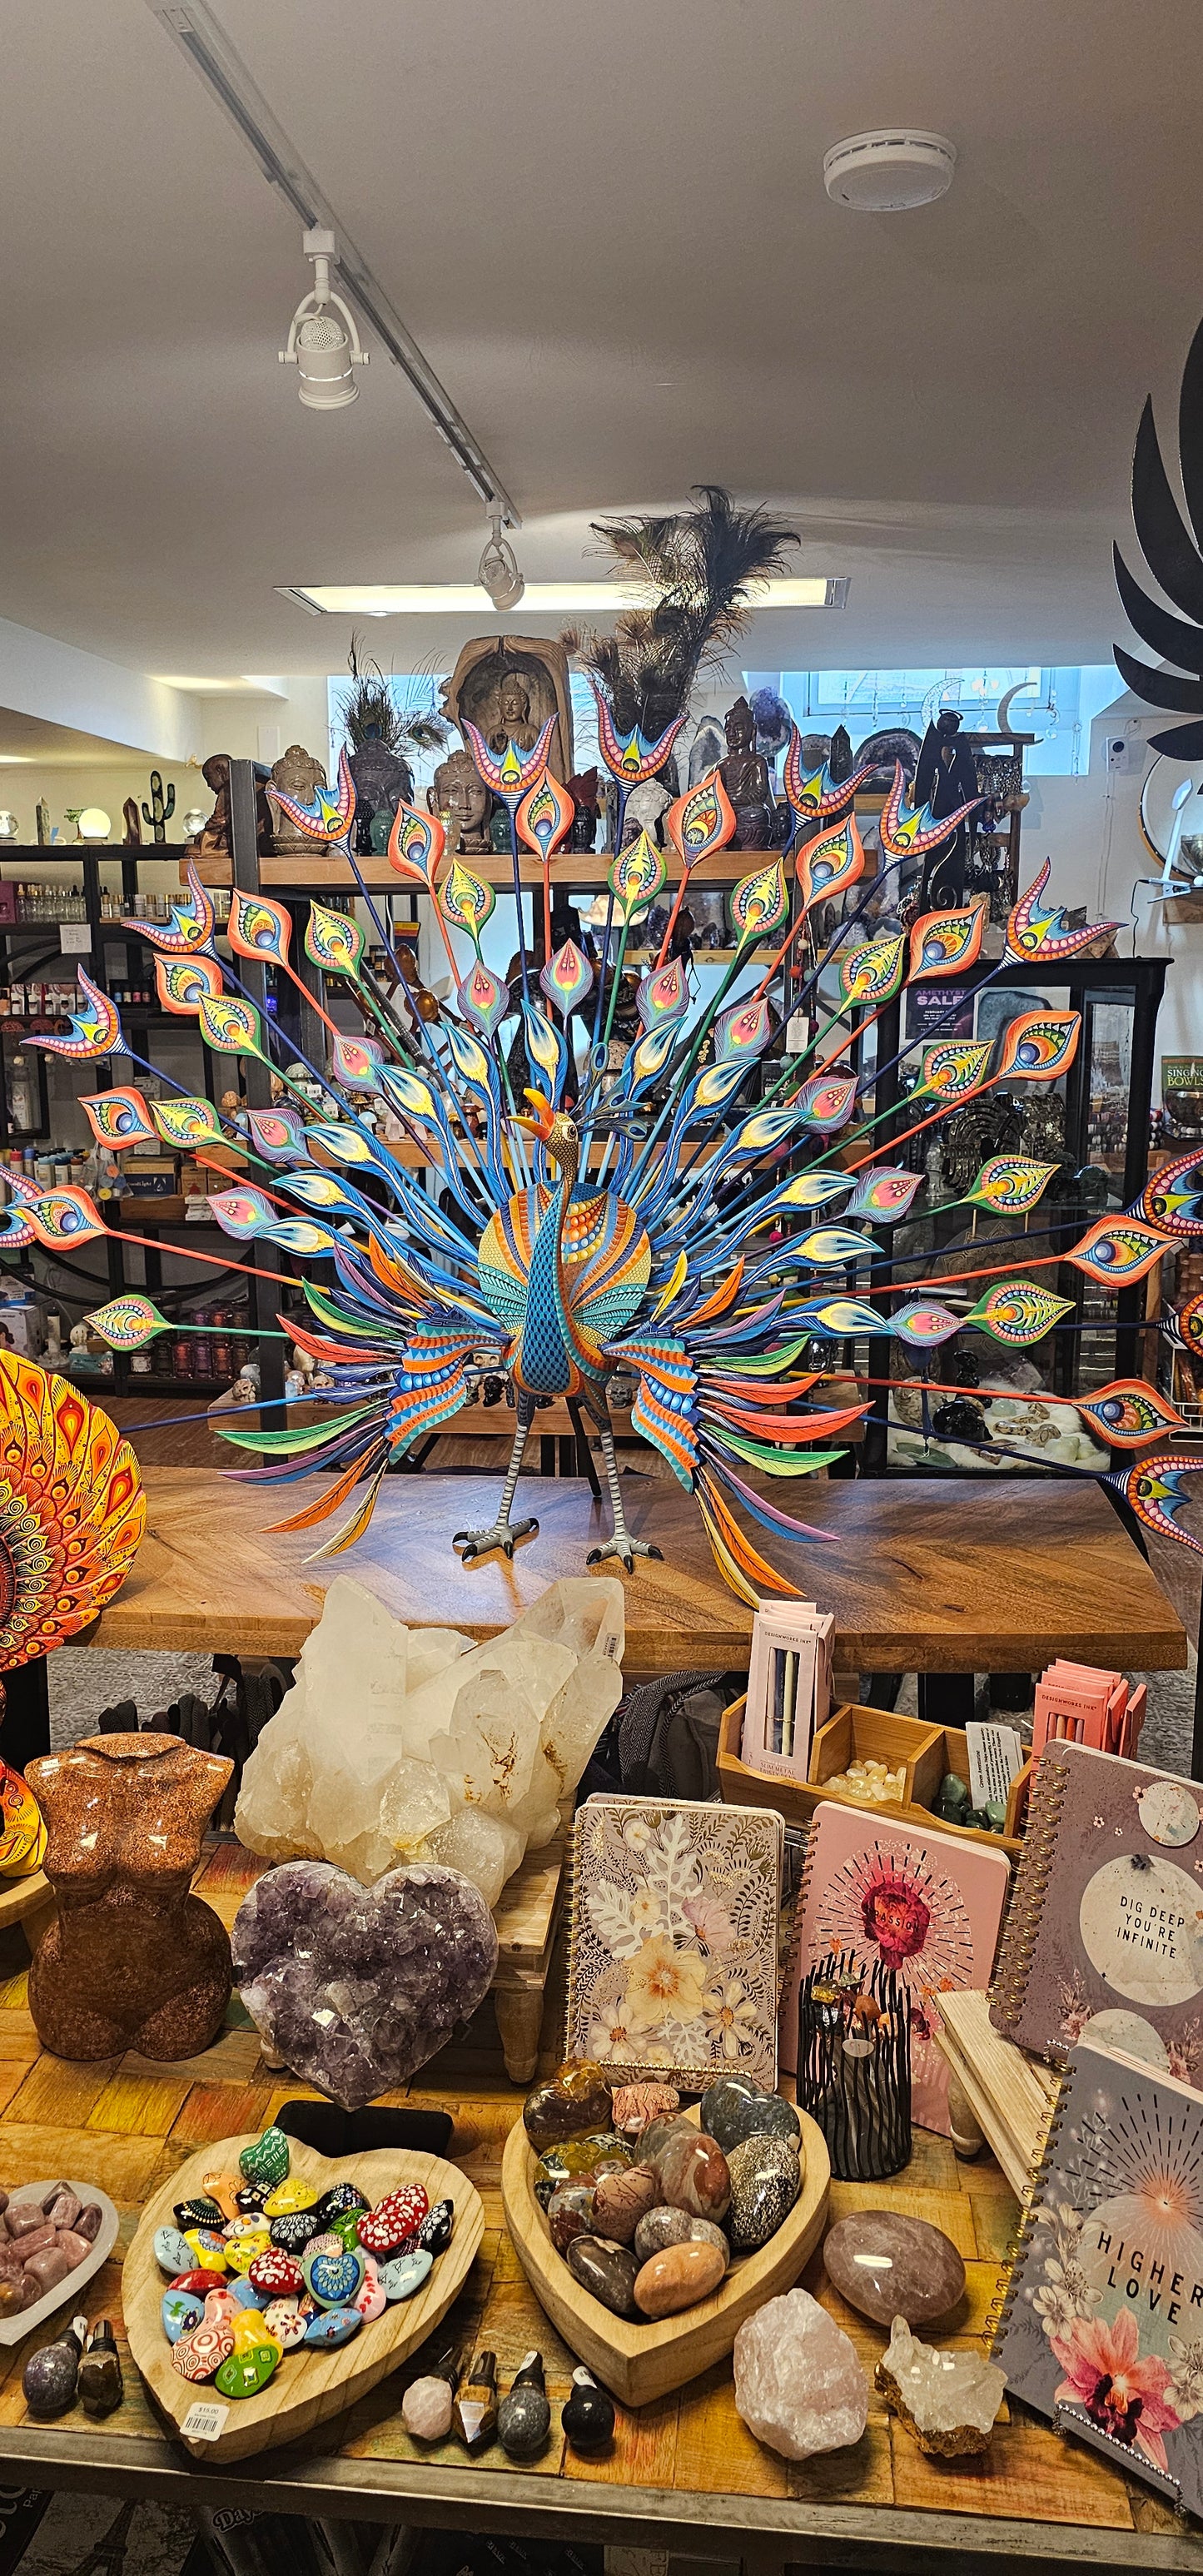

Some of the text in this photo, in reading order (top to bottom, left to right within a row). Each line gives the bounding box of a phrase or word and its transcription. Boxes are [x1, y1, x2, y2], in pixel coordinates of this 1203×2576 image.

[917, 995, 964, 1006] SALE
[764, 1631, 799, 1643] DESIGNWORKS
[1041, 1694, 1082, 1708] DESIGNWORKS
[760, 1762, 773, 1770] SLIM
[775, 1765, 795, 1775] METAL
[874, 1909, 919, 1932] PASSION
[1120, 1895, 1185, 1927] DIG DEEP
[1126, 1913, 1175, 1942] YOU'RE
[1116, 1927, 1176, 1959] INFINITE
[1097, 2230, 1203, 2308] HIGHER
[1107, 2265, 1181, 2325] LOVE
[198, 2406, 219, 2414] $15.00
